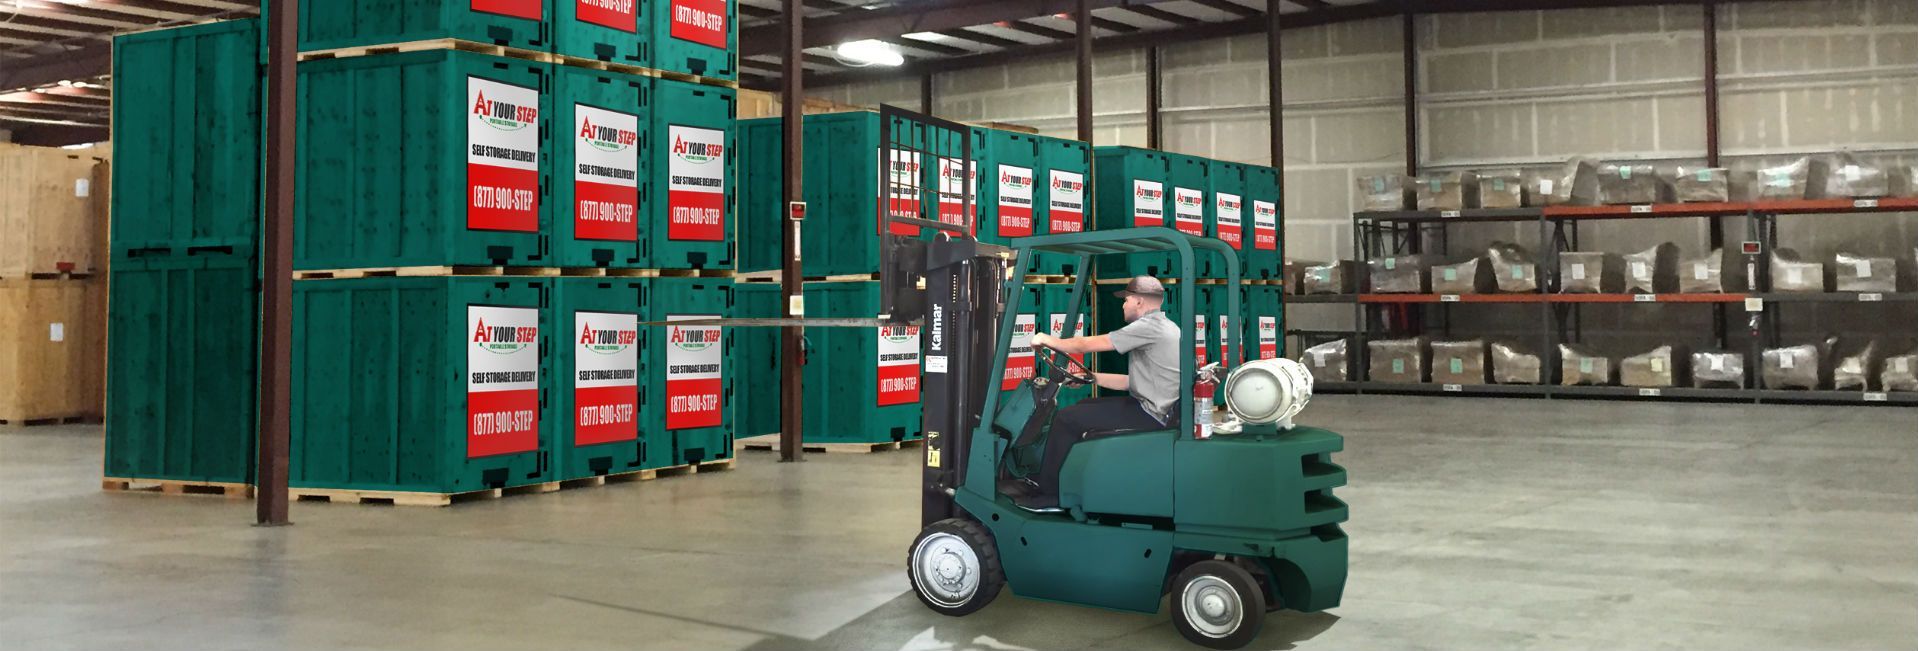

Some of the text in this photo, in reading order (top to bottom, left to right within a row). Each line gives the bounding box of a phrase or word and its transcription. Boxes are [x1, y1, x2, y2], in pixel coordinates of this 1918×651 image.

[676, 4, 722, 32] (877) 900-STEP
[474, 89, 536, 124] At YOUR STEP
[580, 115, 636, 146] At YOUR STEP
[472, 144, 536, 162] SELF STORAGE DELIVERY
[688, 142, 706, 155] YOUR
[706, 144, 722, 157] STEP
[579, 163, 635, 180] SELF STORAGE DELIVERY
[672, 176, 722, 187] SELF STORAGE DELIVERY
[474, 185, 532, 211] (877) 900-STEP
[580, 200, 632, 222] (877) 900-STEP
[673, 207, 719, 224] (877) 900-STEP
[474, 317, 536, 342] At YOUR STEP
[580, 321, 636, 344] At YOUR STEP
[686, 330, 704, 342] YOUR
[704, 330, 720, 342] STEP
[932, 304, 942, 350] Kalmar
[472, 371, 535, 384] SELF STORAGE DELIVERY
[579, 369, 635, 380] SELF STORAGE DELIVERY
[670, 364, 719, 374] SELF STORAGE DELIVERY
[881, 377, 916, 392] (877) 900-STEP
[671, 394, 717, 413] (877) 900-STEP
[474, 410, 532, 435] (877) 900-STEP
[580, 404, 632, 426] (877) 900-STEP
